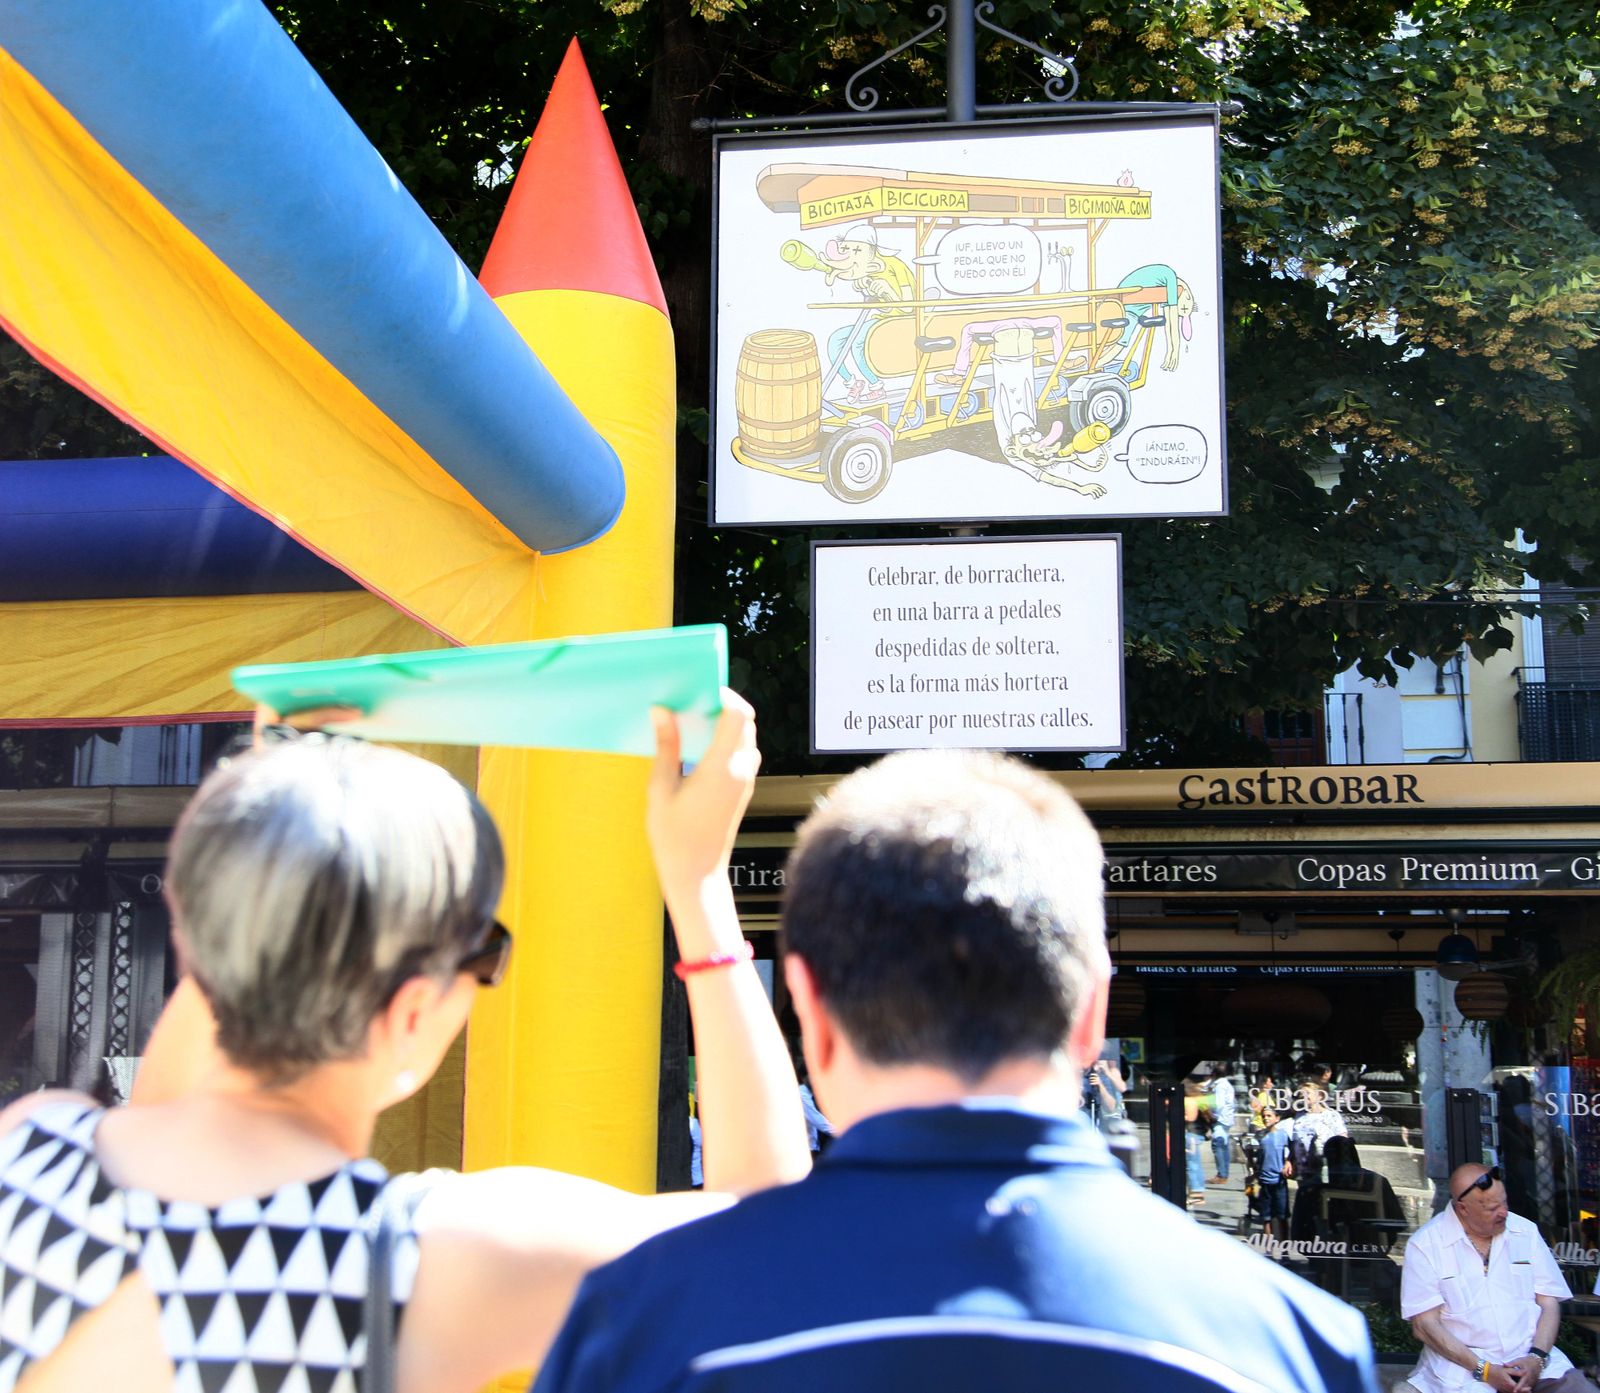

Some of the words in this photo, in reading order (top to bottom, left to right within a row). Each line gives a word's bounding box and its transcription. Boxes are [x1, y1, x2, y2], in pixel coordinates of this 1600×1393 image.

[808, 192, 874, 220] BICITAJÁ
[887, 190, 967, 208] BICICURDA
[1069, 197, 1149, 215] BICIMOÑA.COM
[975, 241, 1005, 251] LLEVO
[1008, 241, 1023, 249] UN
[954, 256, 984, 265] PEDAL
[986, 255, 1008, 265] QUE
[1010, 254, 1026, 263] NO
[954, 269, 986, 278] PUEDO
[988, 268, 1010, 277] CON
[944, 565, 963, 584] de
[873, 607, 892, 621] en
[897, 607, 928, 620] una
[933, 601, 979, 620] barra
[984, 605, 994, 619] a
[999, 599, 1062, 625] pedales
[875, 637, 967, 662] despedidas
[972, 636, 991, 656] de
[867, 679, 885, 693] es
[890, 673, 905, 692] la
[910, 674, 960, 692] forma
[965, 674, 999, 691] más
[1004, 671, 1069, 690] hortera
[844, 710, 862, 730] de
[868, 714, 923, 735] pasear
[929, 714, 957, 734] por
[962, 710, 1035, 728] nuestras
[1040, 707, 1093, 727] calles.
[1103, 860, 1217, 882] artares
[1298, 858, 1386, 888] Copas
[1400, 856, 1540, 881] Premium
[1243, 1233, 1347, 1255] Alhambra
